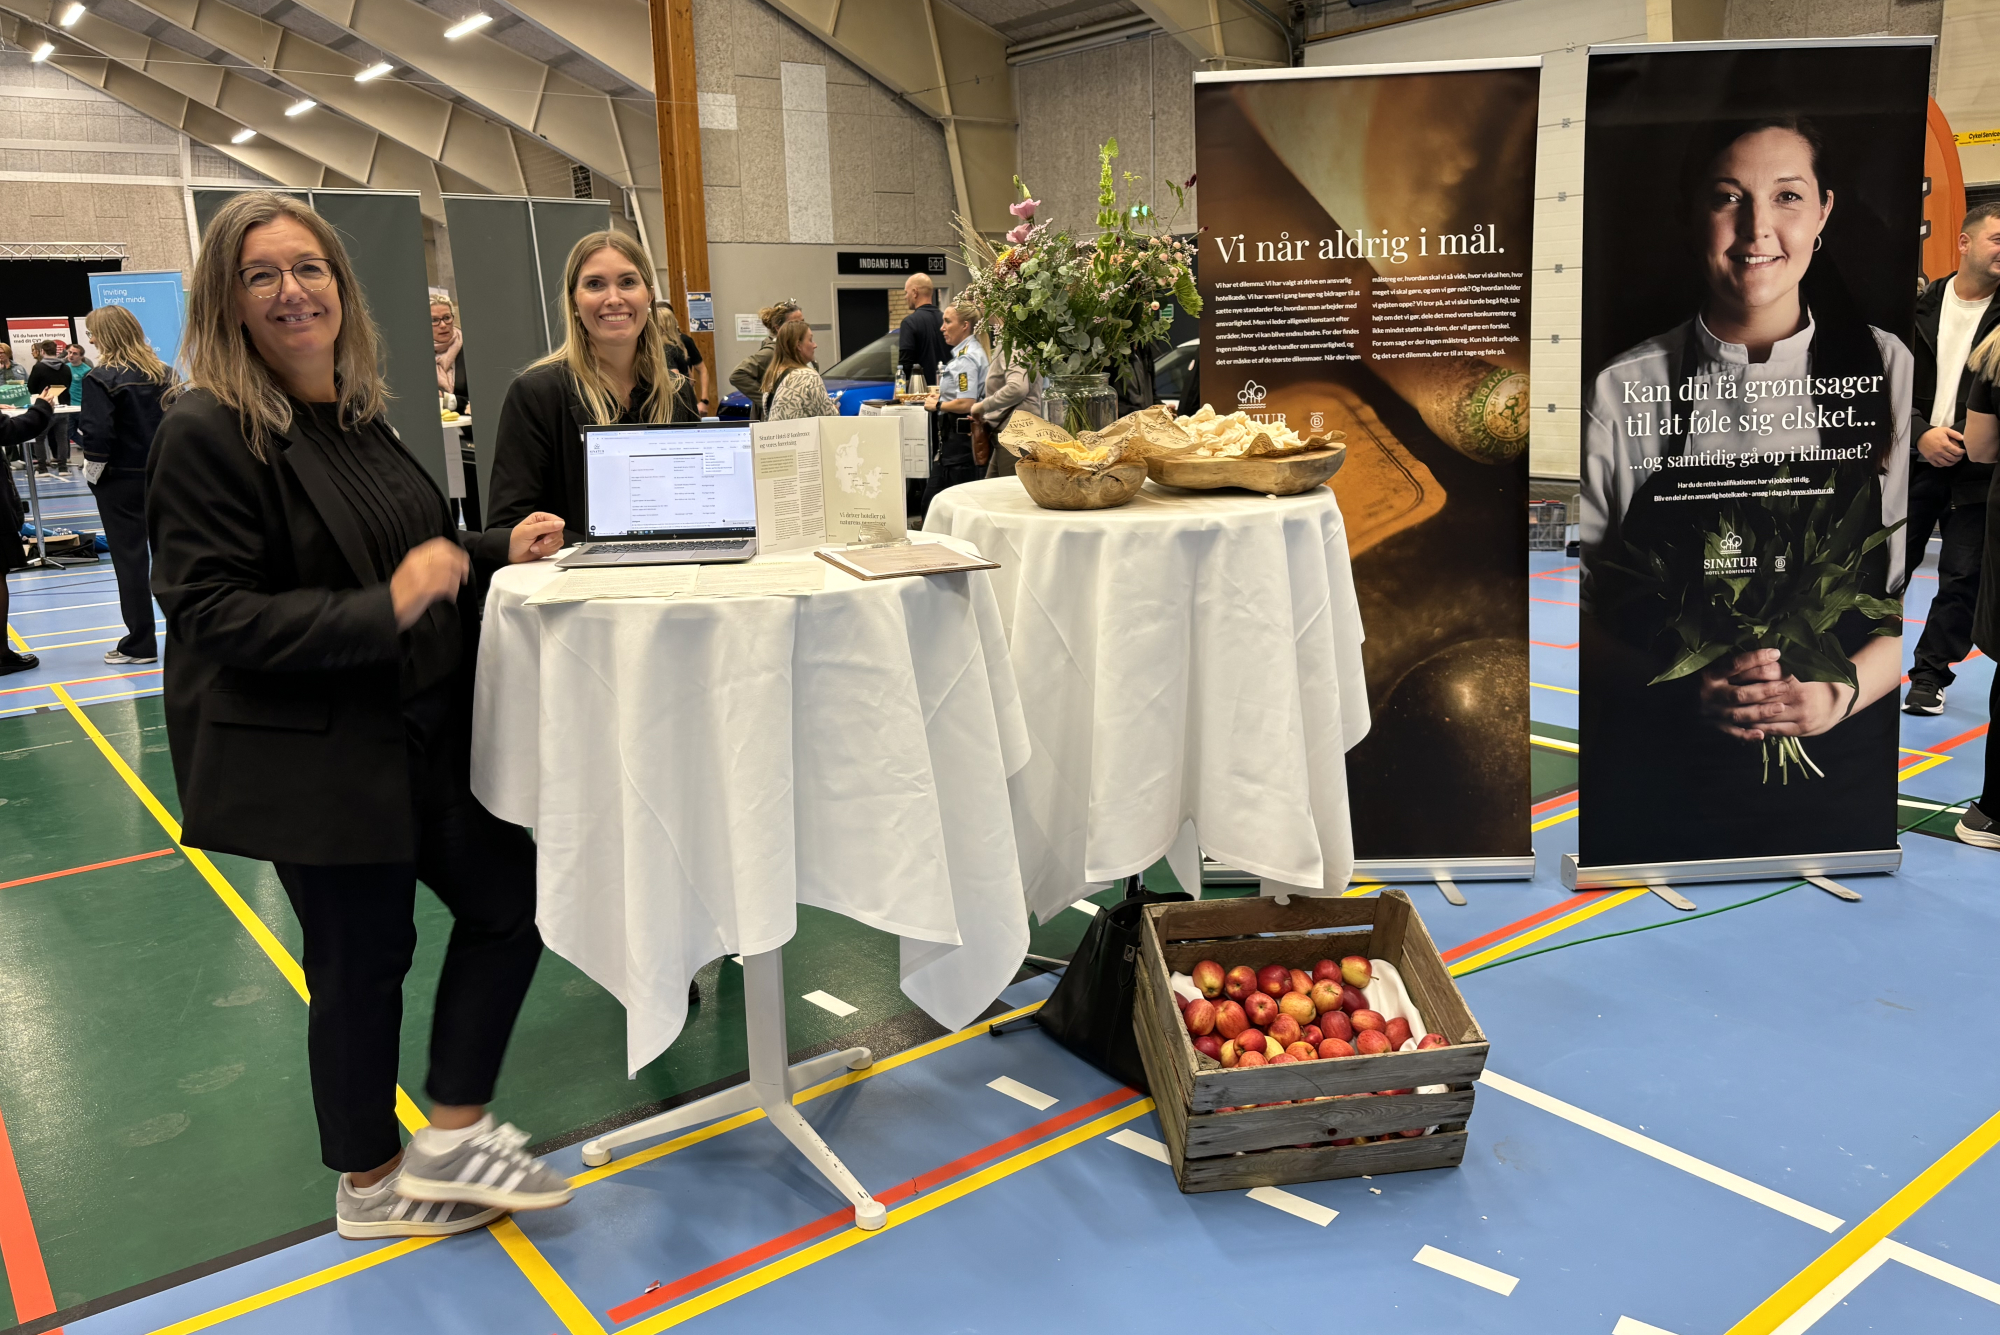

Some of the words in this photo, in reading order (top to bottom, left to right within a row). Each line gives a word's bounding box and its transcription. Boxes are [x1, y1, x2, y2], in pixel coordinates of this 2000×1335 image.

[1215, 234, 1247, 263] Vi
[1256, 231, 1310, 262] når
[1318, 228, 1409, 264] aldrig
[1419, 227, 1429, 256] i
[1438, 223, 1505, 256] mål.
[860, 258, 888, 268] INDGANG
[890, 259, 903, 268] HAL
[904, 259, 909, 268] 5
[1622, 381, 1670, 404] Kan
[1679, 377, 1710, 402] du
[1715, 375, 1738, 399] få
[1744, 374, 1883, 403] grøntsager
[1626, 413, 1651, 437] til
[1659, 414, 1682, 435] at
[1688, 410, 1731, 435] føle
[1738, 408, 1774, 435] sig
[1781, 405, 1876, 430] elsket...
[1629, 455, 1663, 472] ...og
[1667, 450, 1736, 469] samtidig
[1740, 447, 1759, 468] gå
[1764, 448, 1785, 466] op
[1790, 446, 1795, 462] i
[1799, 443, 1872, 462] klimaet?
[1704, 557, 1757, 569] SINATUR
